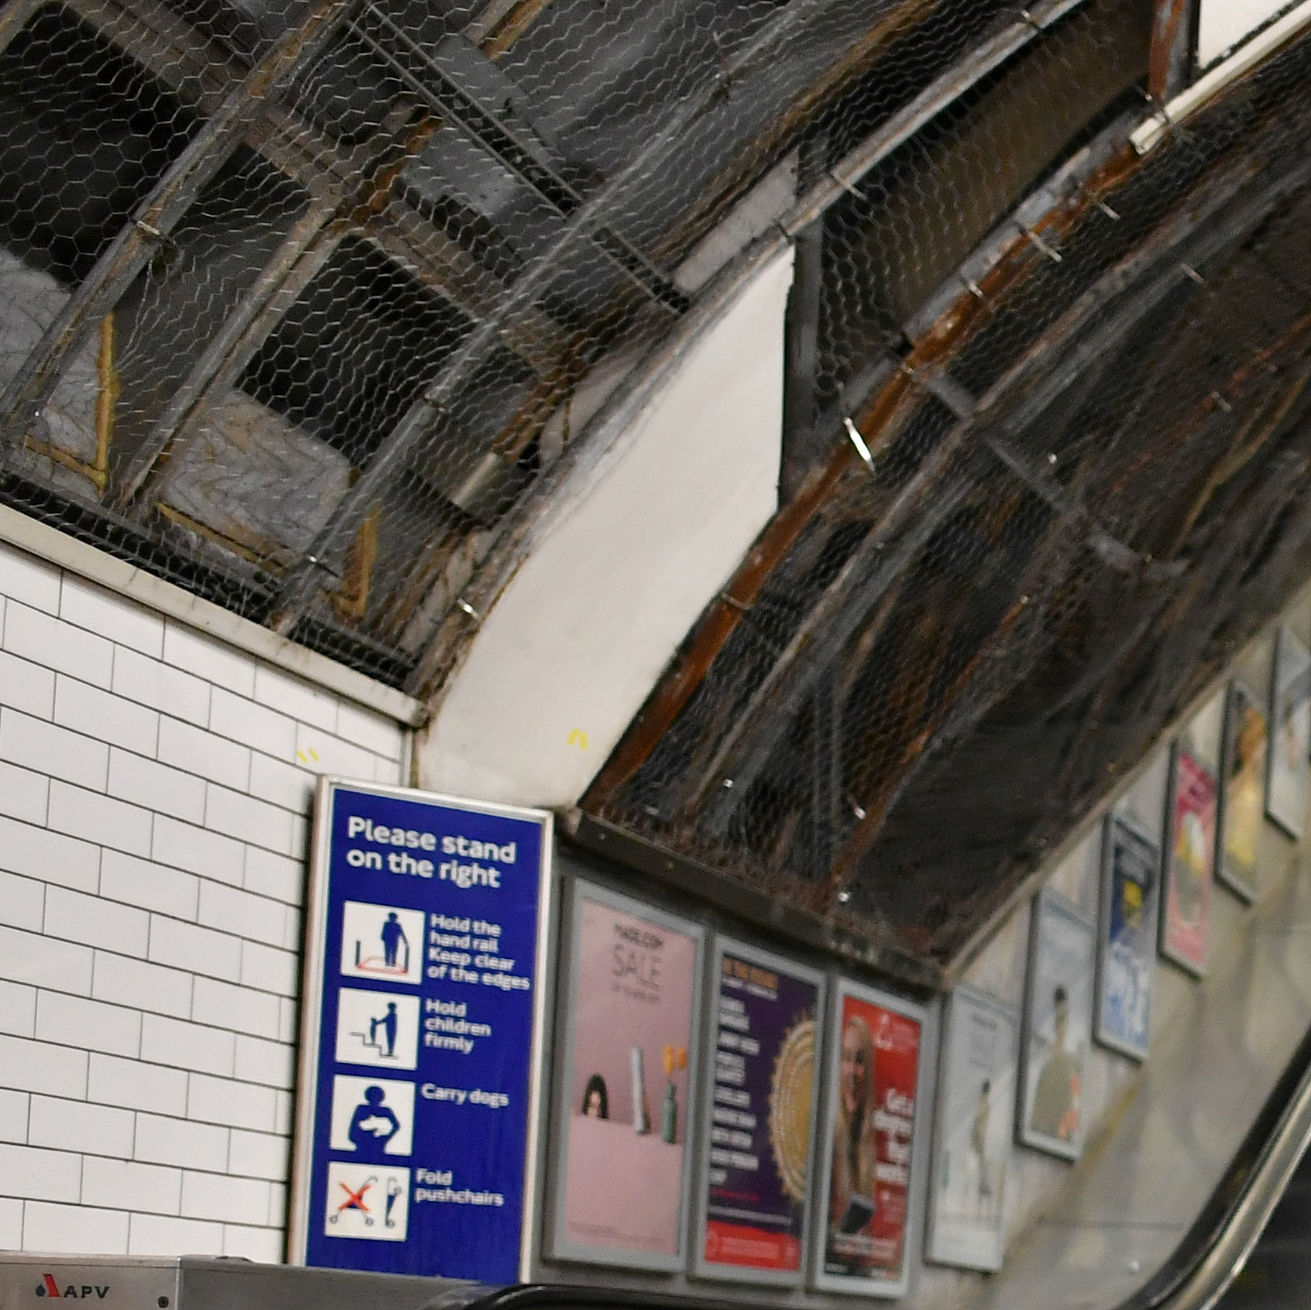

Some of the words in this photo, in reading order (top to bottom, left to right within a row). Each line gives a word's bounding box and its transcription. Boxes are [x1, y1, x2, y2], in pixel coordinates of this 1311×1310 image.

[347, 816, 436, 850] Please
[442, 835, 517, 864] stand
[346, 849, 382, 870] on
[388, 852, 434, 878] the
[439, 860, 501, 888] right
[431, 913, 471, 933] Hold
[472, 920, 502, 937] the
[430, 930, 471, 949] hand
[472, 936, 499, 953] rail
[428, 946, 471, 966] Keep
[474, 953, 516, 971] clear
[427, 964, 448, 979] of
[450, 965, 479, 984] the
[482, 971, 530, 991] edges
[425, 997, 467, 1017] Hold
[425, 1016, 491, 1037] children
[425, 1031, 474, 1055] firmly
[421, 1083, 467, 1105] Carry
[469, 1088, 509, 1109] dogs
[415, 1167, 453, 1186] Fold
[415, 1187, 504, 1207] pushchairs
[64, 1286, 110, 1300] APV
